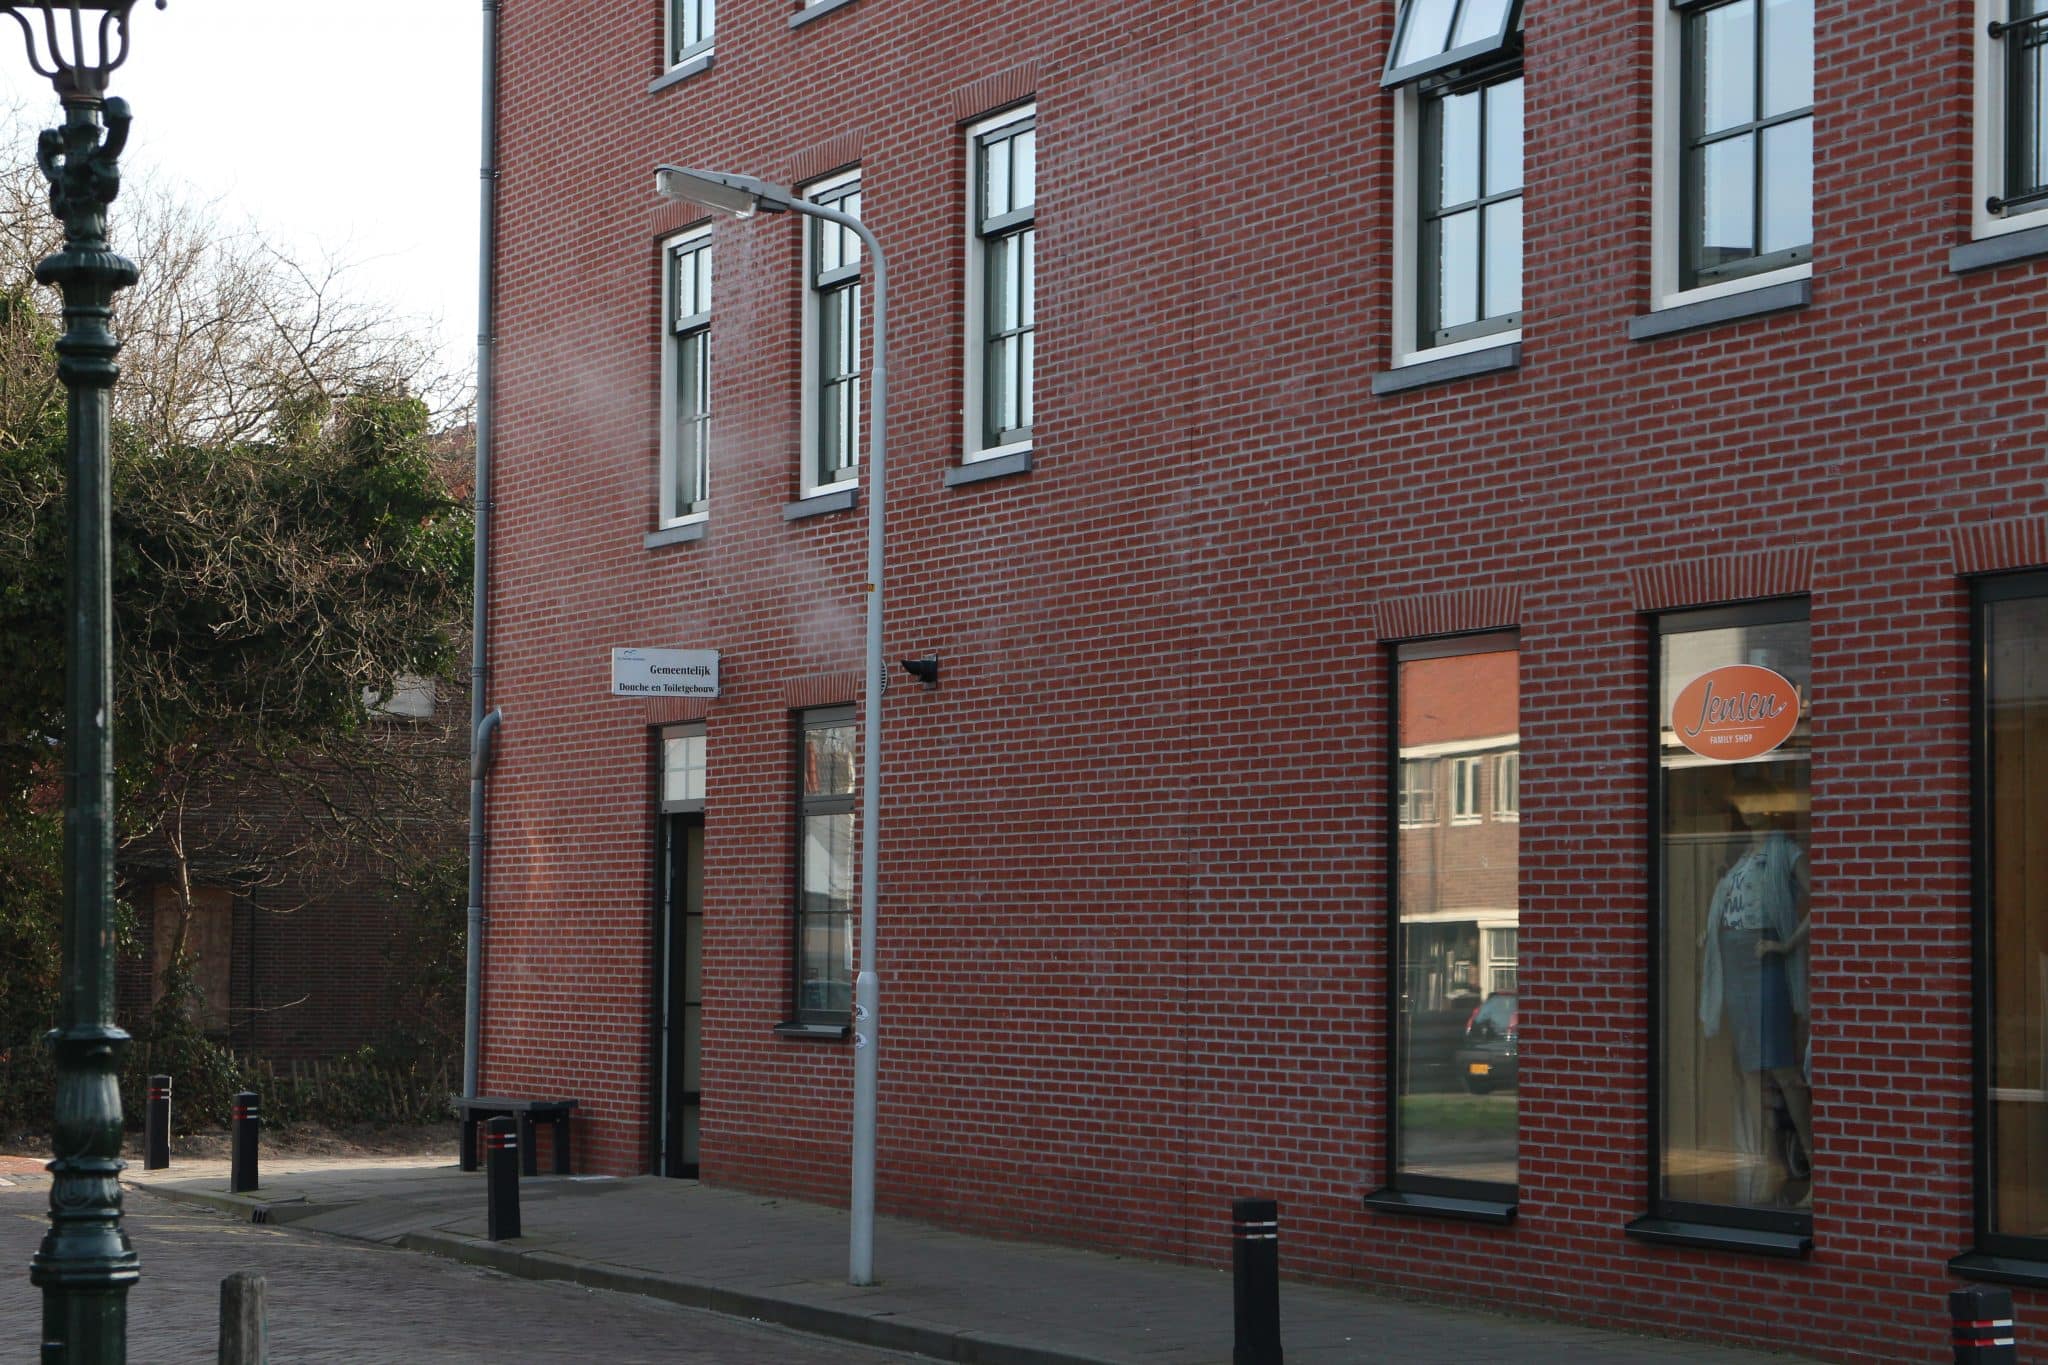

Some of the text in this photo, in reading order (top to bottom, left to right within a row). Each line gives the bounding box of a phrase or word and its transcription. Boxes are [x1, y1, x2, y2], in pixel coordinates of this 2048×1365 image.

[650, 664, 711, 677] Gemeentelijk
[619, 683, 648, 692] Douche
[663, 683, 714, 694] Toiletgebouw
[1684, 680, 1787, 737] Jensen
[1710, 733, 1752, 744] FAMILY SHOP
